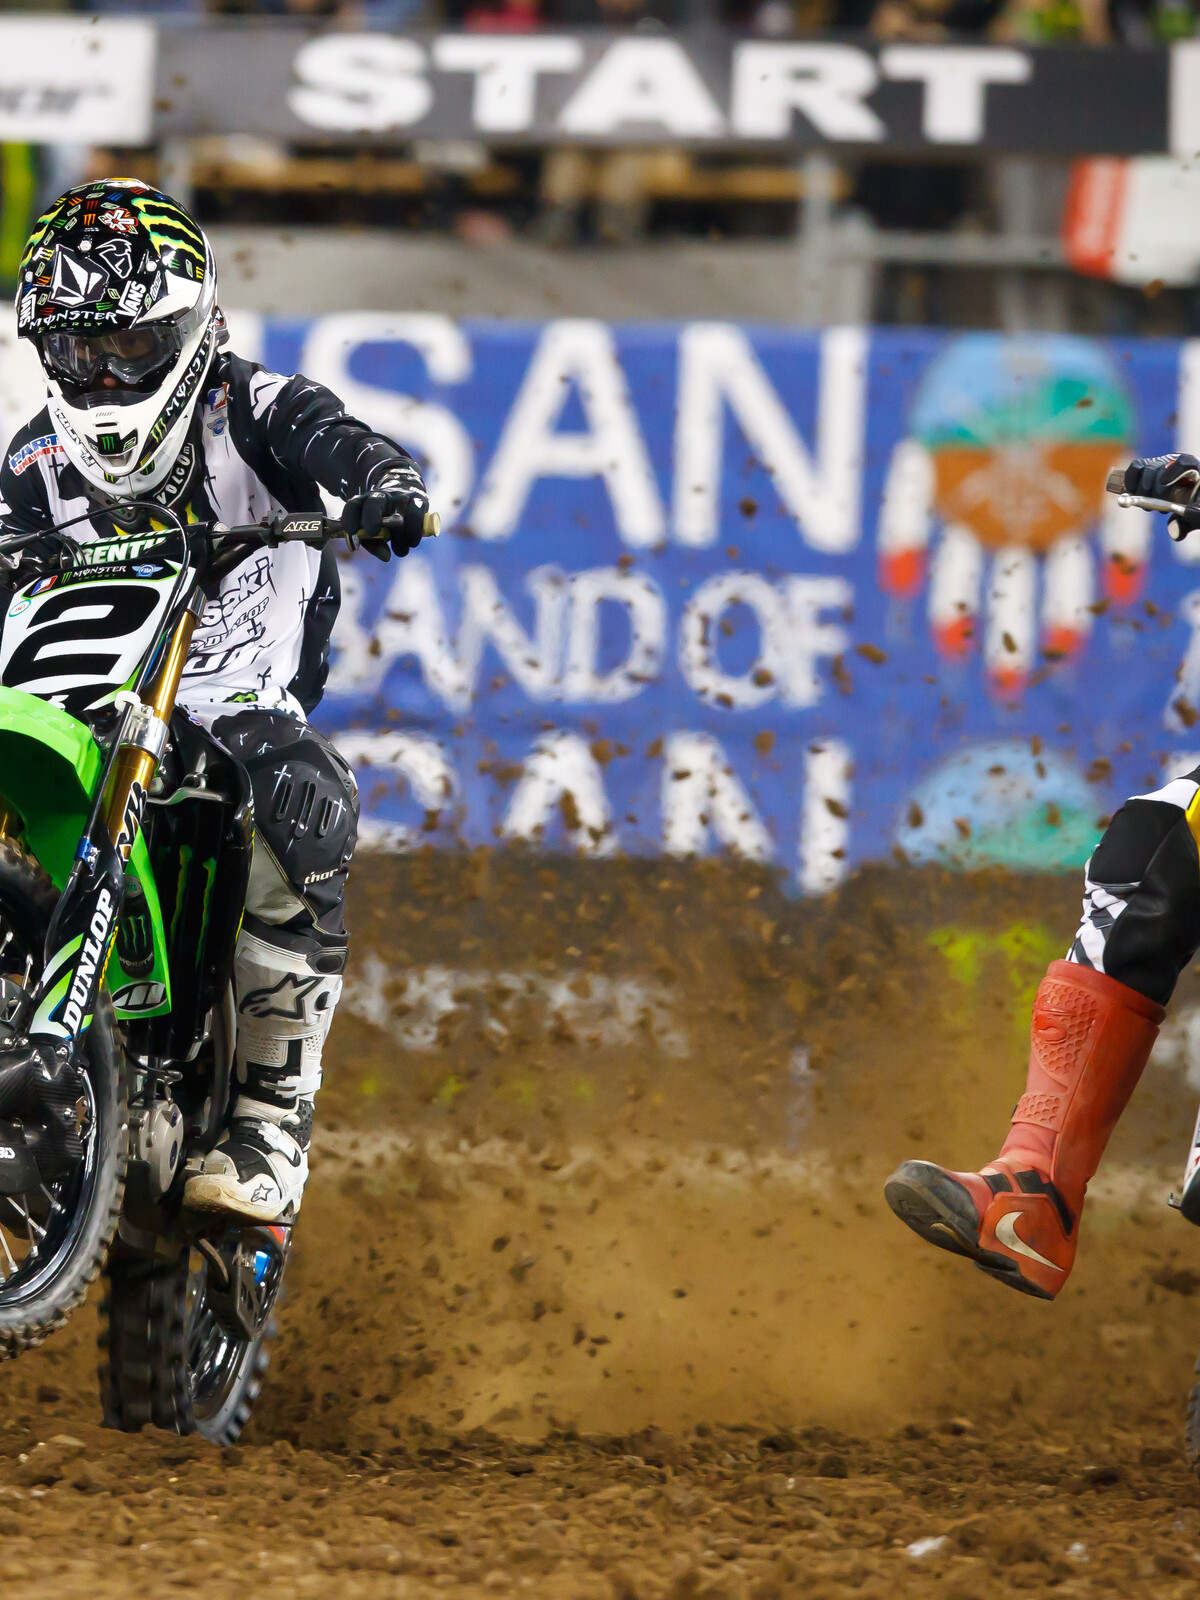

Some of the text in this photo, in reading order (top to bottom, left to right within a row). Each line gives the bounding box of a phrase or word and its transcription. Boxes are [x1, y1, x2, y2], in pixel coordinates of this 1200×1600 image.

[287, 33, 1033, 144] START
[116, 280, 147, 317] VANS
[29, 310, 118, 329] MONSTER
[302, 310, 869, 556] SAN
[10, 434, 58, 468] PART
[15, 445, 64, 475] UNLIMIT
[283, 520, 321, 533] ARC
[73, 565, 126, 577] MONSTER
[2, 585, 161, 687] 2
[681, 571, 852, 711] OF
[304, 868, 338, 885] thor
[62, 888, 113, 1036] DUNLOP
